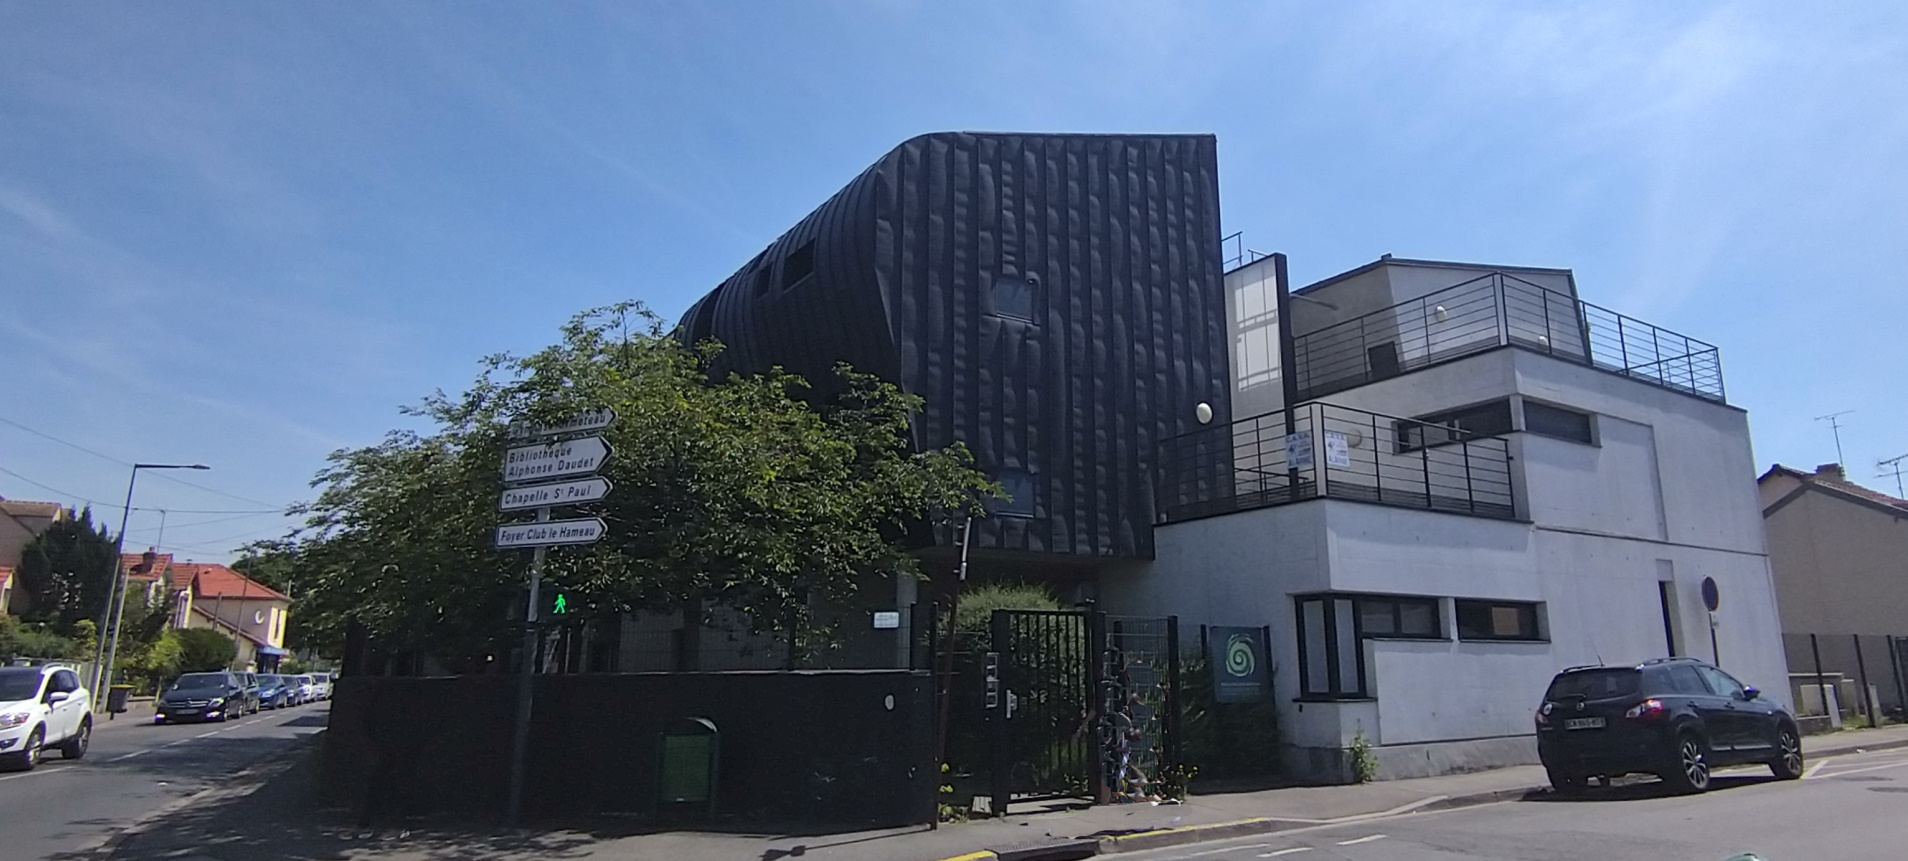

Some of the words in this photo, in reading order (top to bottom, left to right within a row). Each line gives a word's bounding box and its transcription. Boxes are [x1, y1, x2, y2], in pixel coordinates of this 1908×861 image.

[508, 463, 553, 478] Alphonse
[557, 457, 595, 471] Daudet
[504, 489, 549, 505] Chapelle
[553, 487, 565, 499] St
[567, 484, 592, 498] Paul
[501, 530, 525, 543] Foyer
[526, 527, 547, 540] Club
[548, 527, 558, 539] le
[559, 526, 596, 539] Hameau
